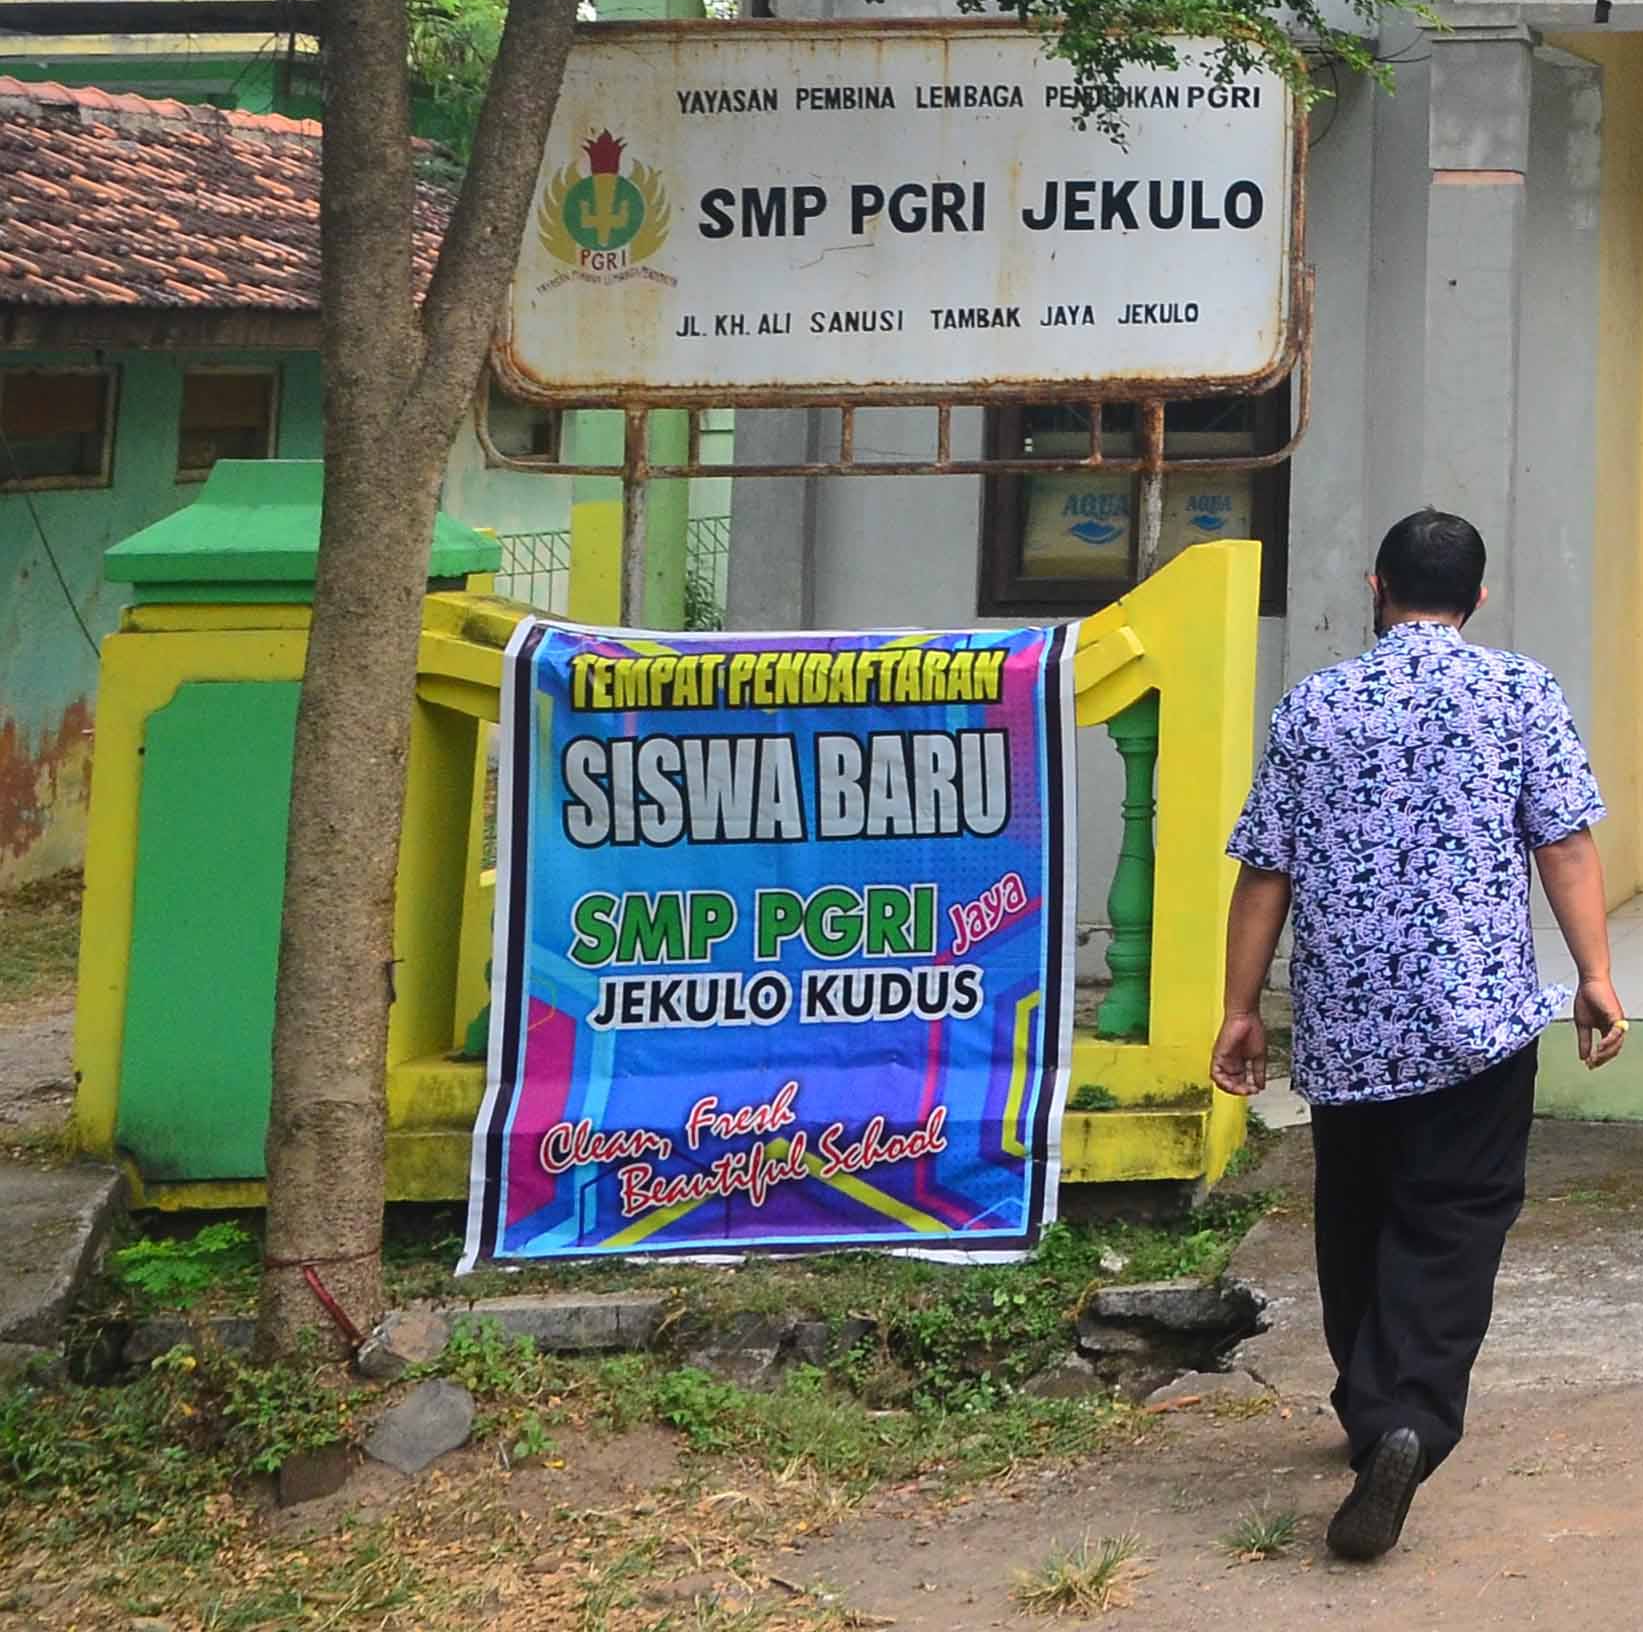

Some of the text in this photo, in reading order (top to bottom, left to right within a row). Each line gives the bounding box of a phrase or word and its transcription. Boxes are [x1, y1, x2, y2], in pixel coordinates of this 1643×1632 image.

[677, 87, 778, 114] YAYASAN
[796, 86, 895, 110] PEMBINA
[915, 85, 1024, 109] LEMBAGA
[1187, 85, 1261, 110] PGRI
[698, 179, 1263, 240] SMP PGRI JEKULO
[581, 249, 626, 271] PGRI
[676, 302, 1199, 338] JL. KH. ALI SANUSI TAMBAK JAYA JEKULO
[569, 646, 1010, 710] TEMPAT PENDAFTARAN
[563, 729, 1010, 848] SISWA BARU
[569, 871, 1028, 967] SMP PGRI Jaya
[592, 965, 984, 1029] JEKULO KUDUS
[540, 1080, 799, 1174] Clean, Fresh
[621, 1105, 948, 1216] Beautiful School
